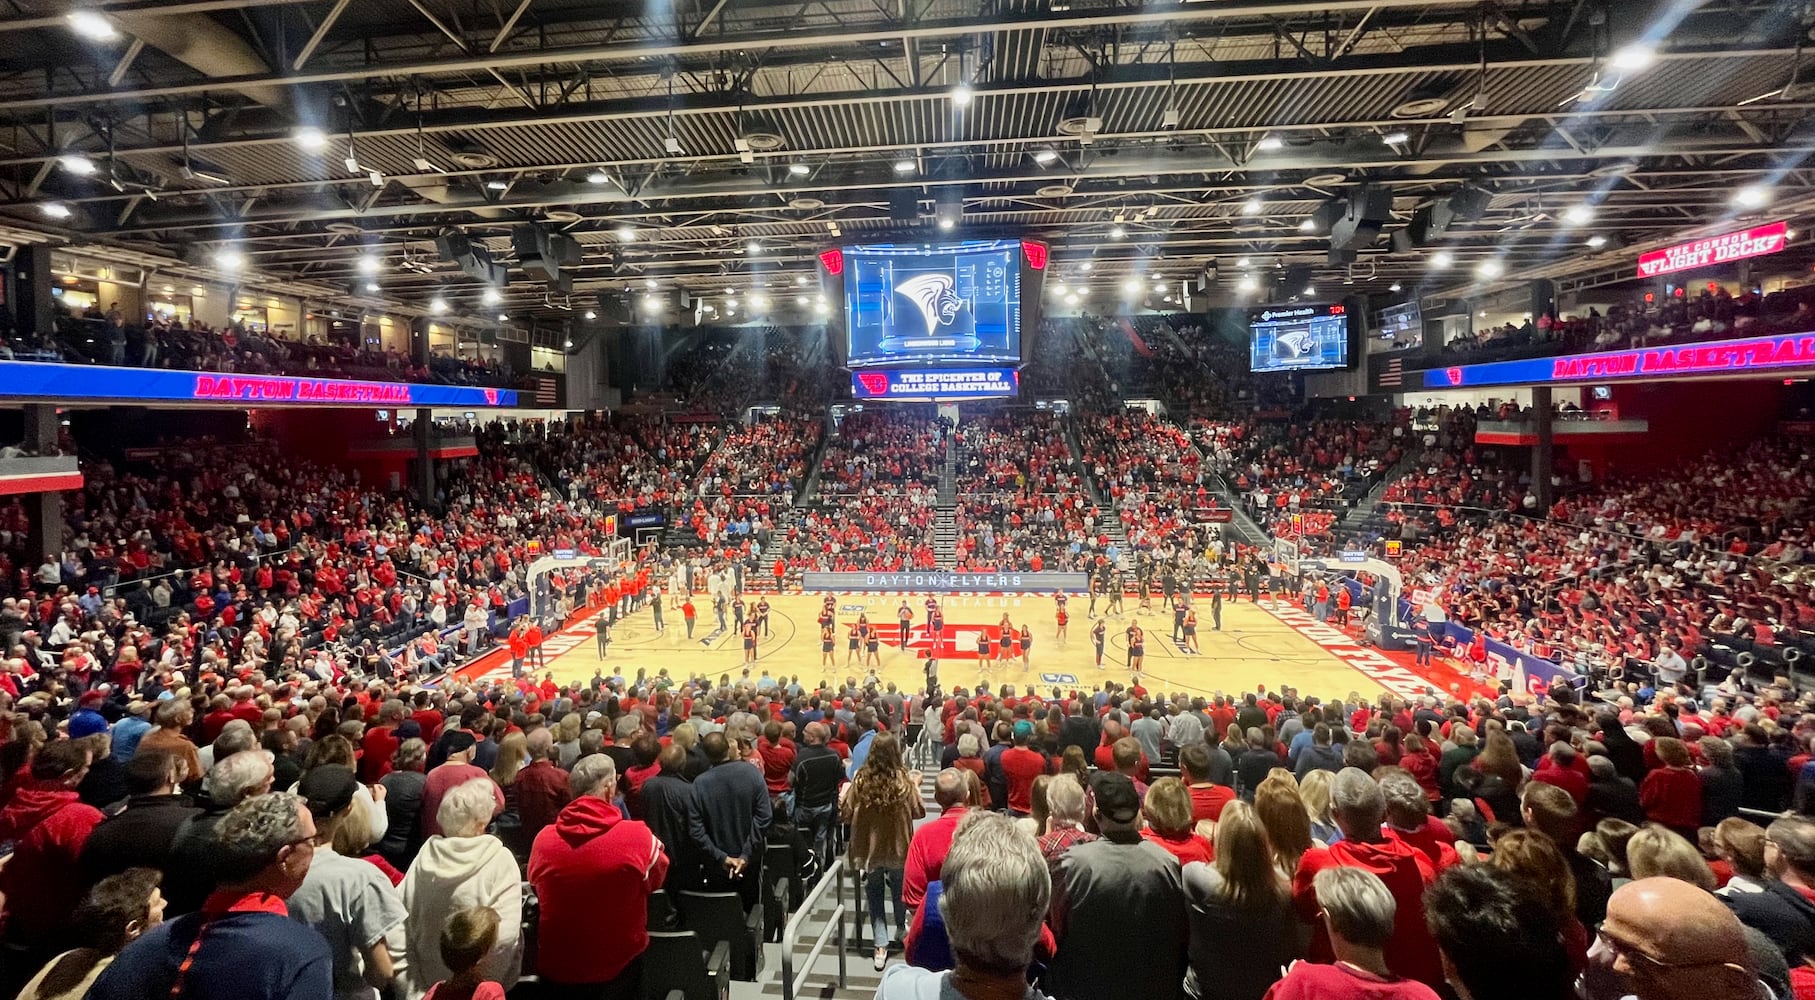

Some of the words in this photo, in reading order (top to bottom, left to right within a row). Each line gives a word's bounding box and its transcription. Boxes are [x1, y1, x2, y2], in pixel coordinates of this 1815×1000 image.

[1665, 246, 1689, 258] THE
[1694, 233, 1749, 251] CONNOR
[1646, 249, 1712, 274] FLIGHT
[1714, 236, 1770, 261] DECK
[1294, 308, 1314, 316] Health
[1552, 352, 1640, 378] DAYTON
[900, 373, 923, 383] THE
[925, 372, 986, 383] EPICENTER
[987, 371, 1002, 382] OF
[195, 376, 296, 399] DAYTON
[297, 381, 411, 402] BASKETBALL
[891, 383, 939, 393] COLLEGE
[941, 381, 1011, 392] BASKETBALL
[867, 575, 937, 585] DAYTON
[950, 575, 1021, 585] FLYERS
